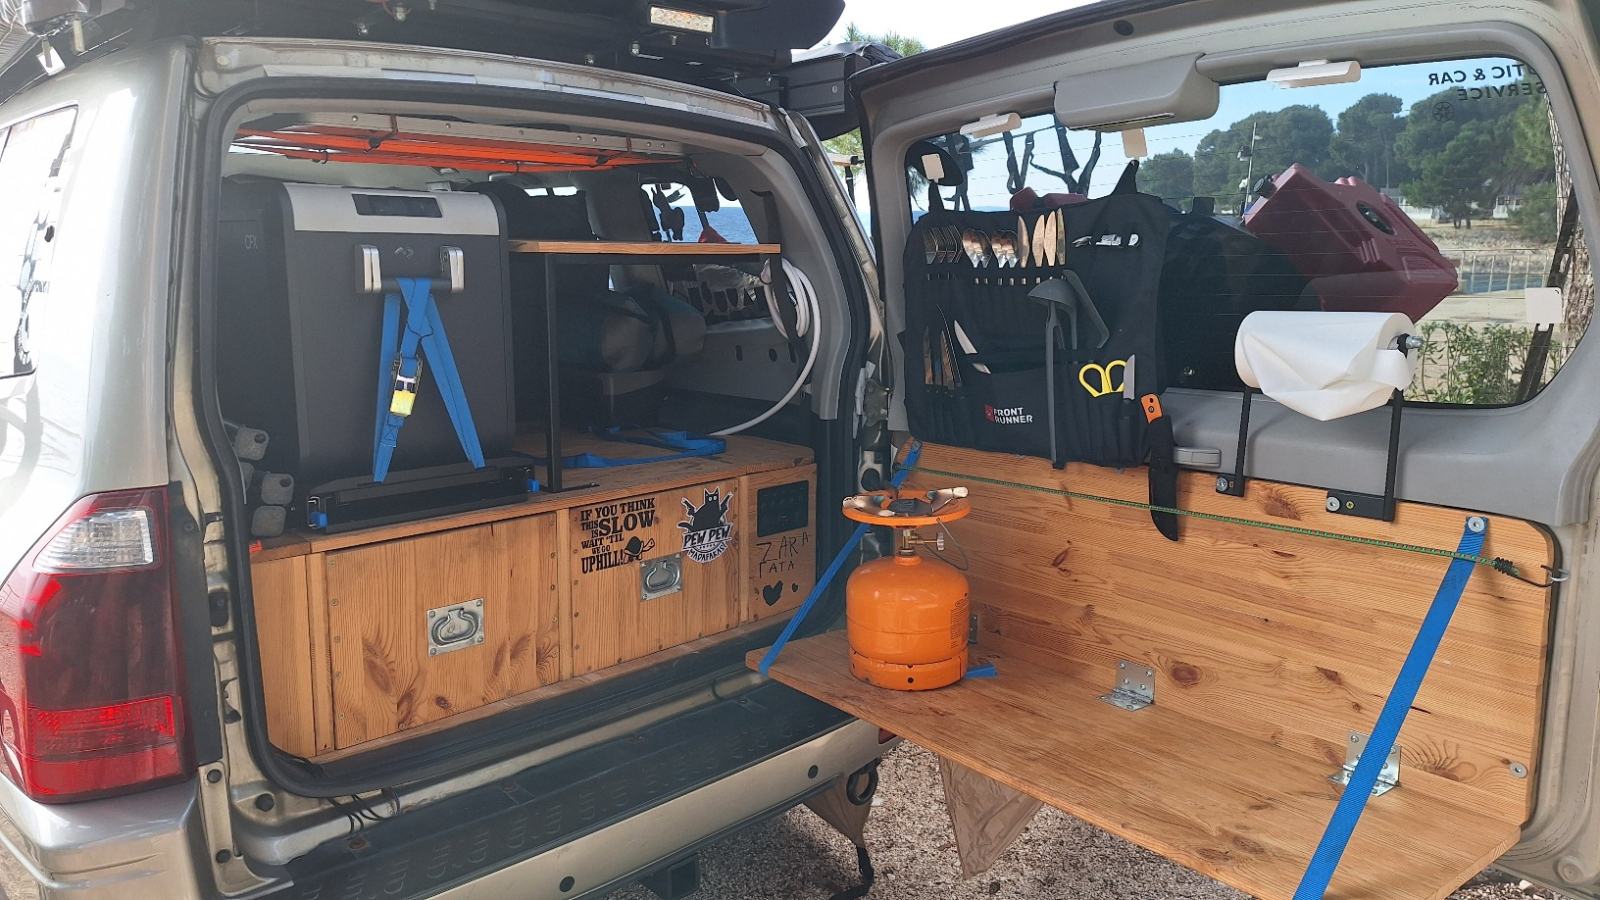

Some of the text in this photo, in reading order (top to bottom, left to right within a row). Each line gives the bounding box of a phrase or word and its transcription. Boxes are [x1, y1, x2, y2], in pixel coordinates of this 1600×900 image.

[993, 407, 1024, 417] FRONT
[994, 414, 1033, 425] RUNNER
[581, 497, 656, 522] IF YOU THINK
[581, 510, 656, 539] THIS IS SLOW
[581, 537, 604, 549] WAIT
[684, 525, 731, 547] PEW PEW
[756, 530, 809, 561] ZARA
[592, 545, 611, 555] WE GO
[581, 549, 624, 574] UPHILL!
